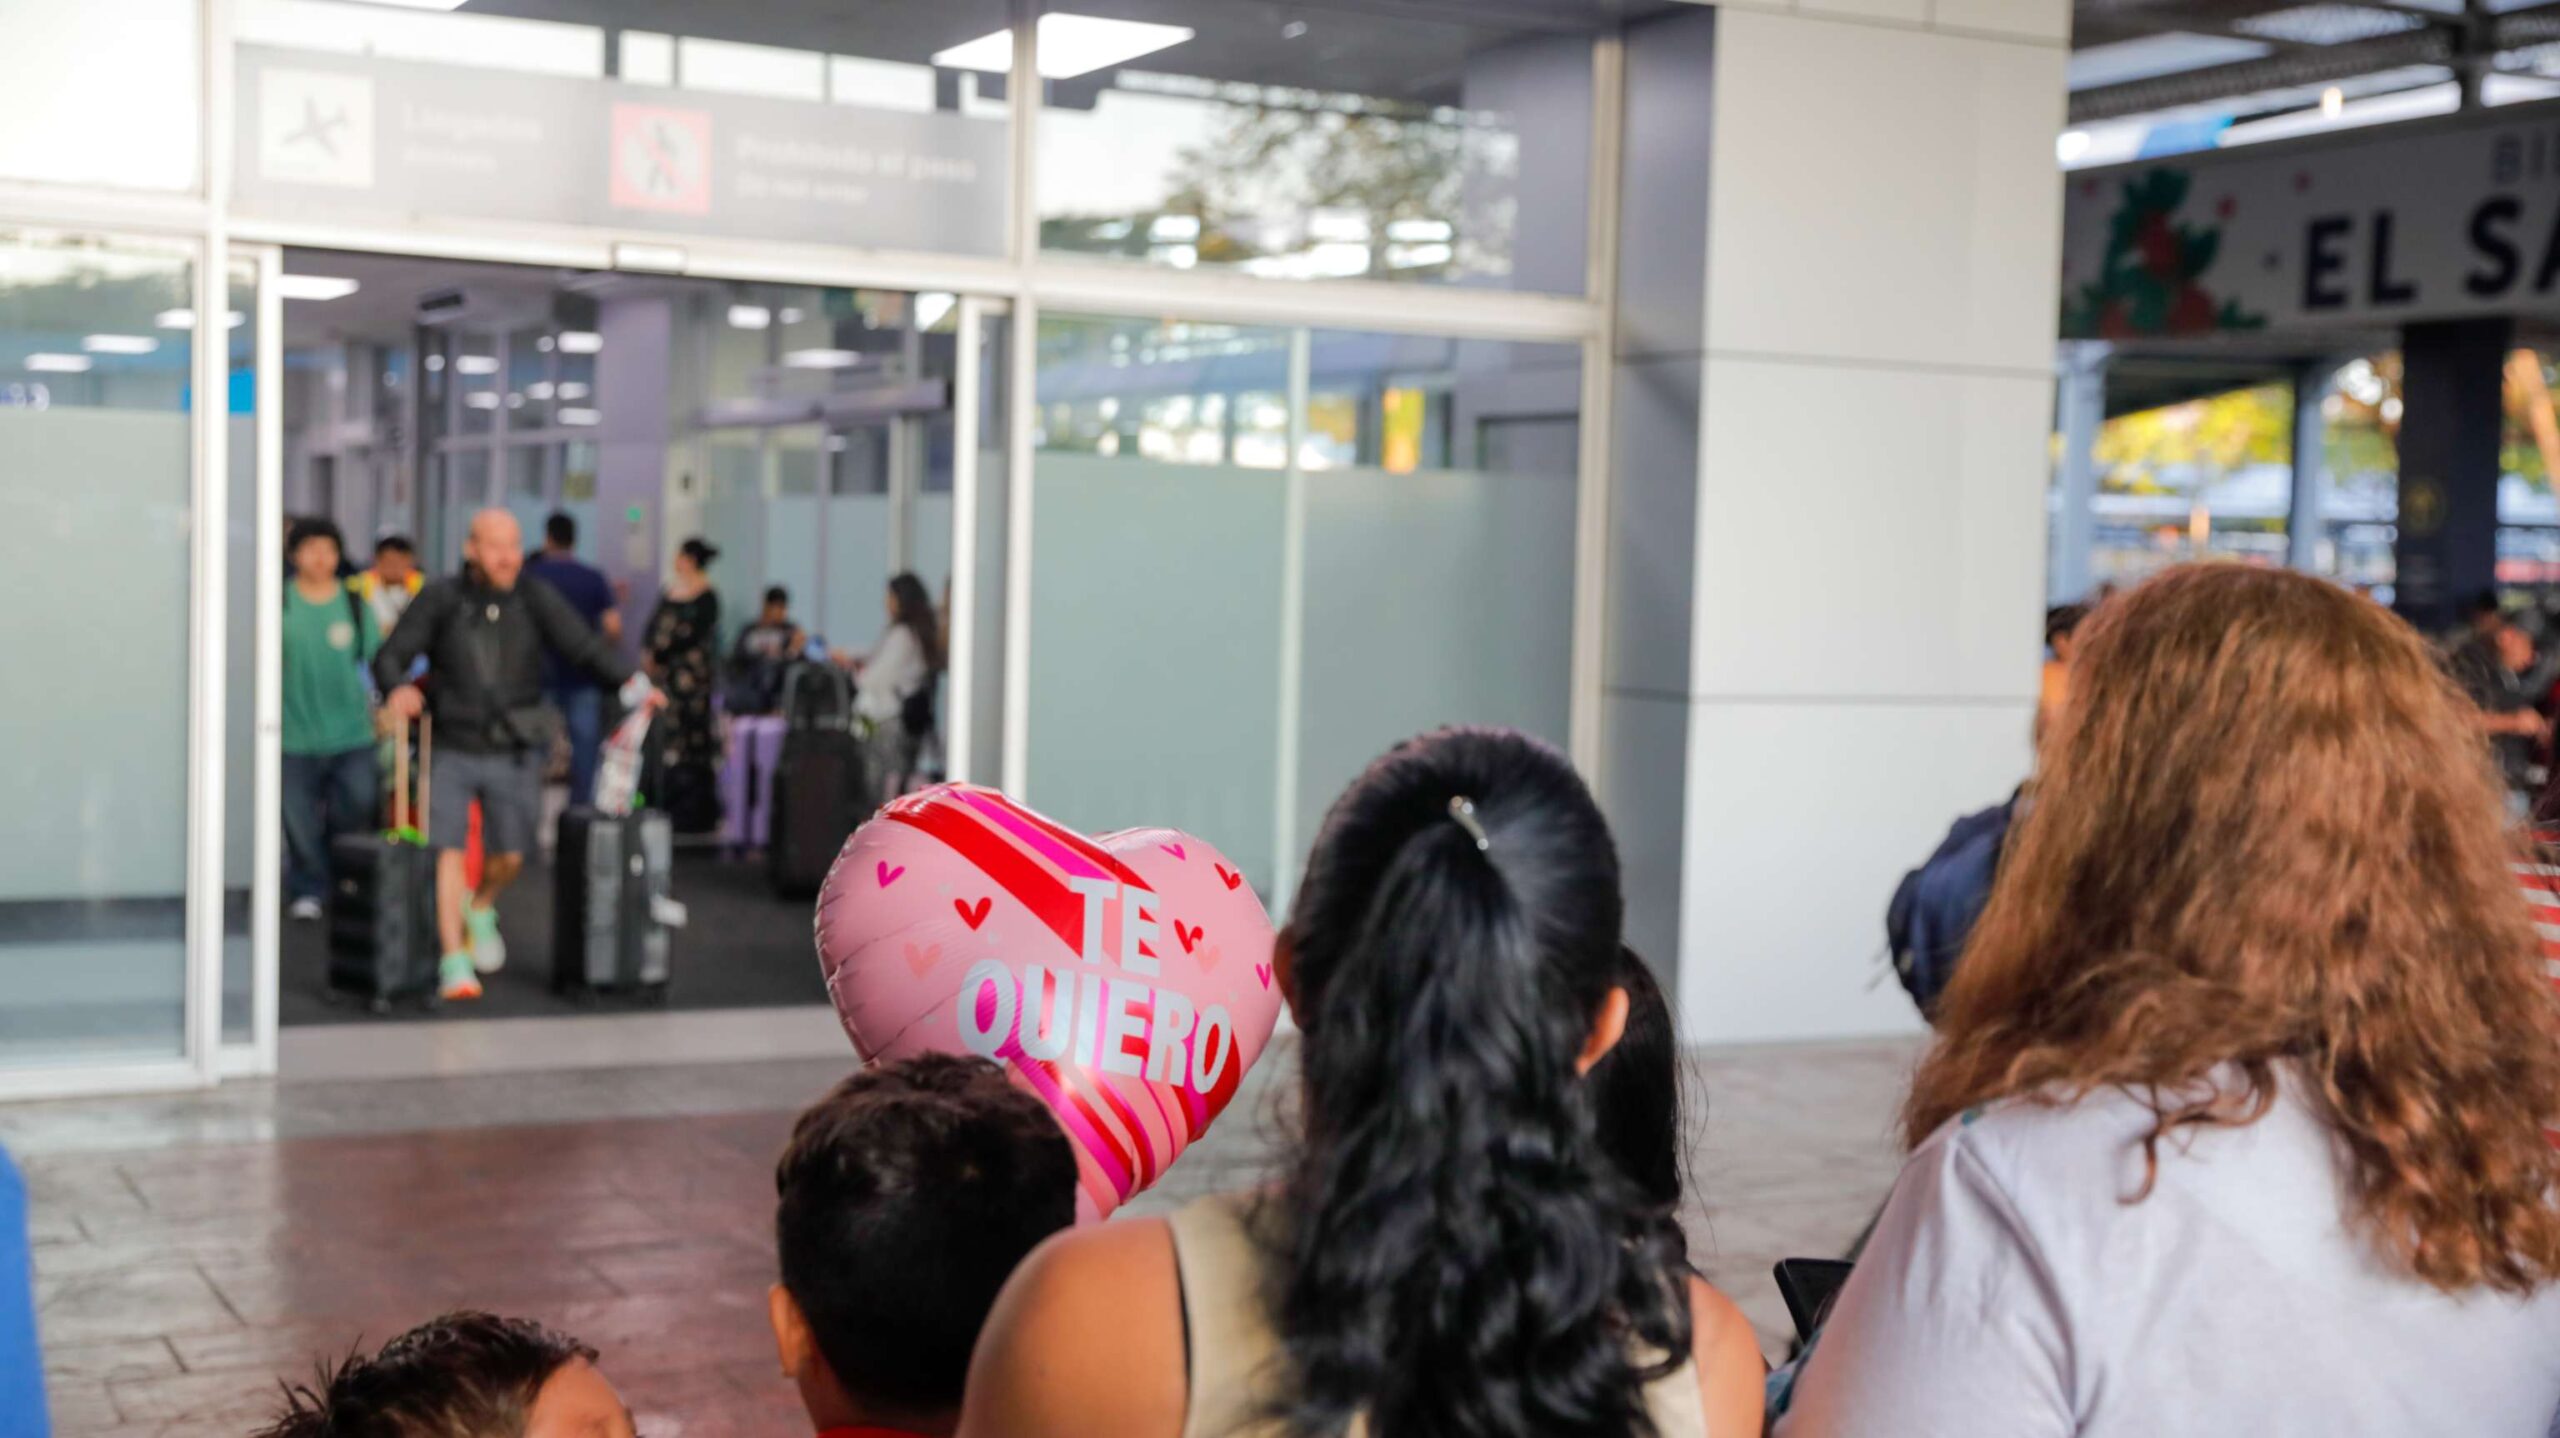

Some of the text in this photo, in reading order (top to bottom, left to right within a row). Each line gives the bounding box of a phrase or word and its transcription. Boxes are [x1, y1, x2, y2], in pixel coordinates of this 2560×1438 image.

[2305, 211, 2418, 309] EL
[1070, 875, 1160, 977] TE
[957, 958, 1231, 1094] QUIERO
